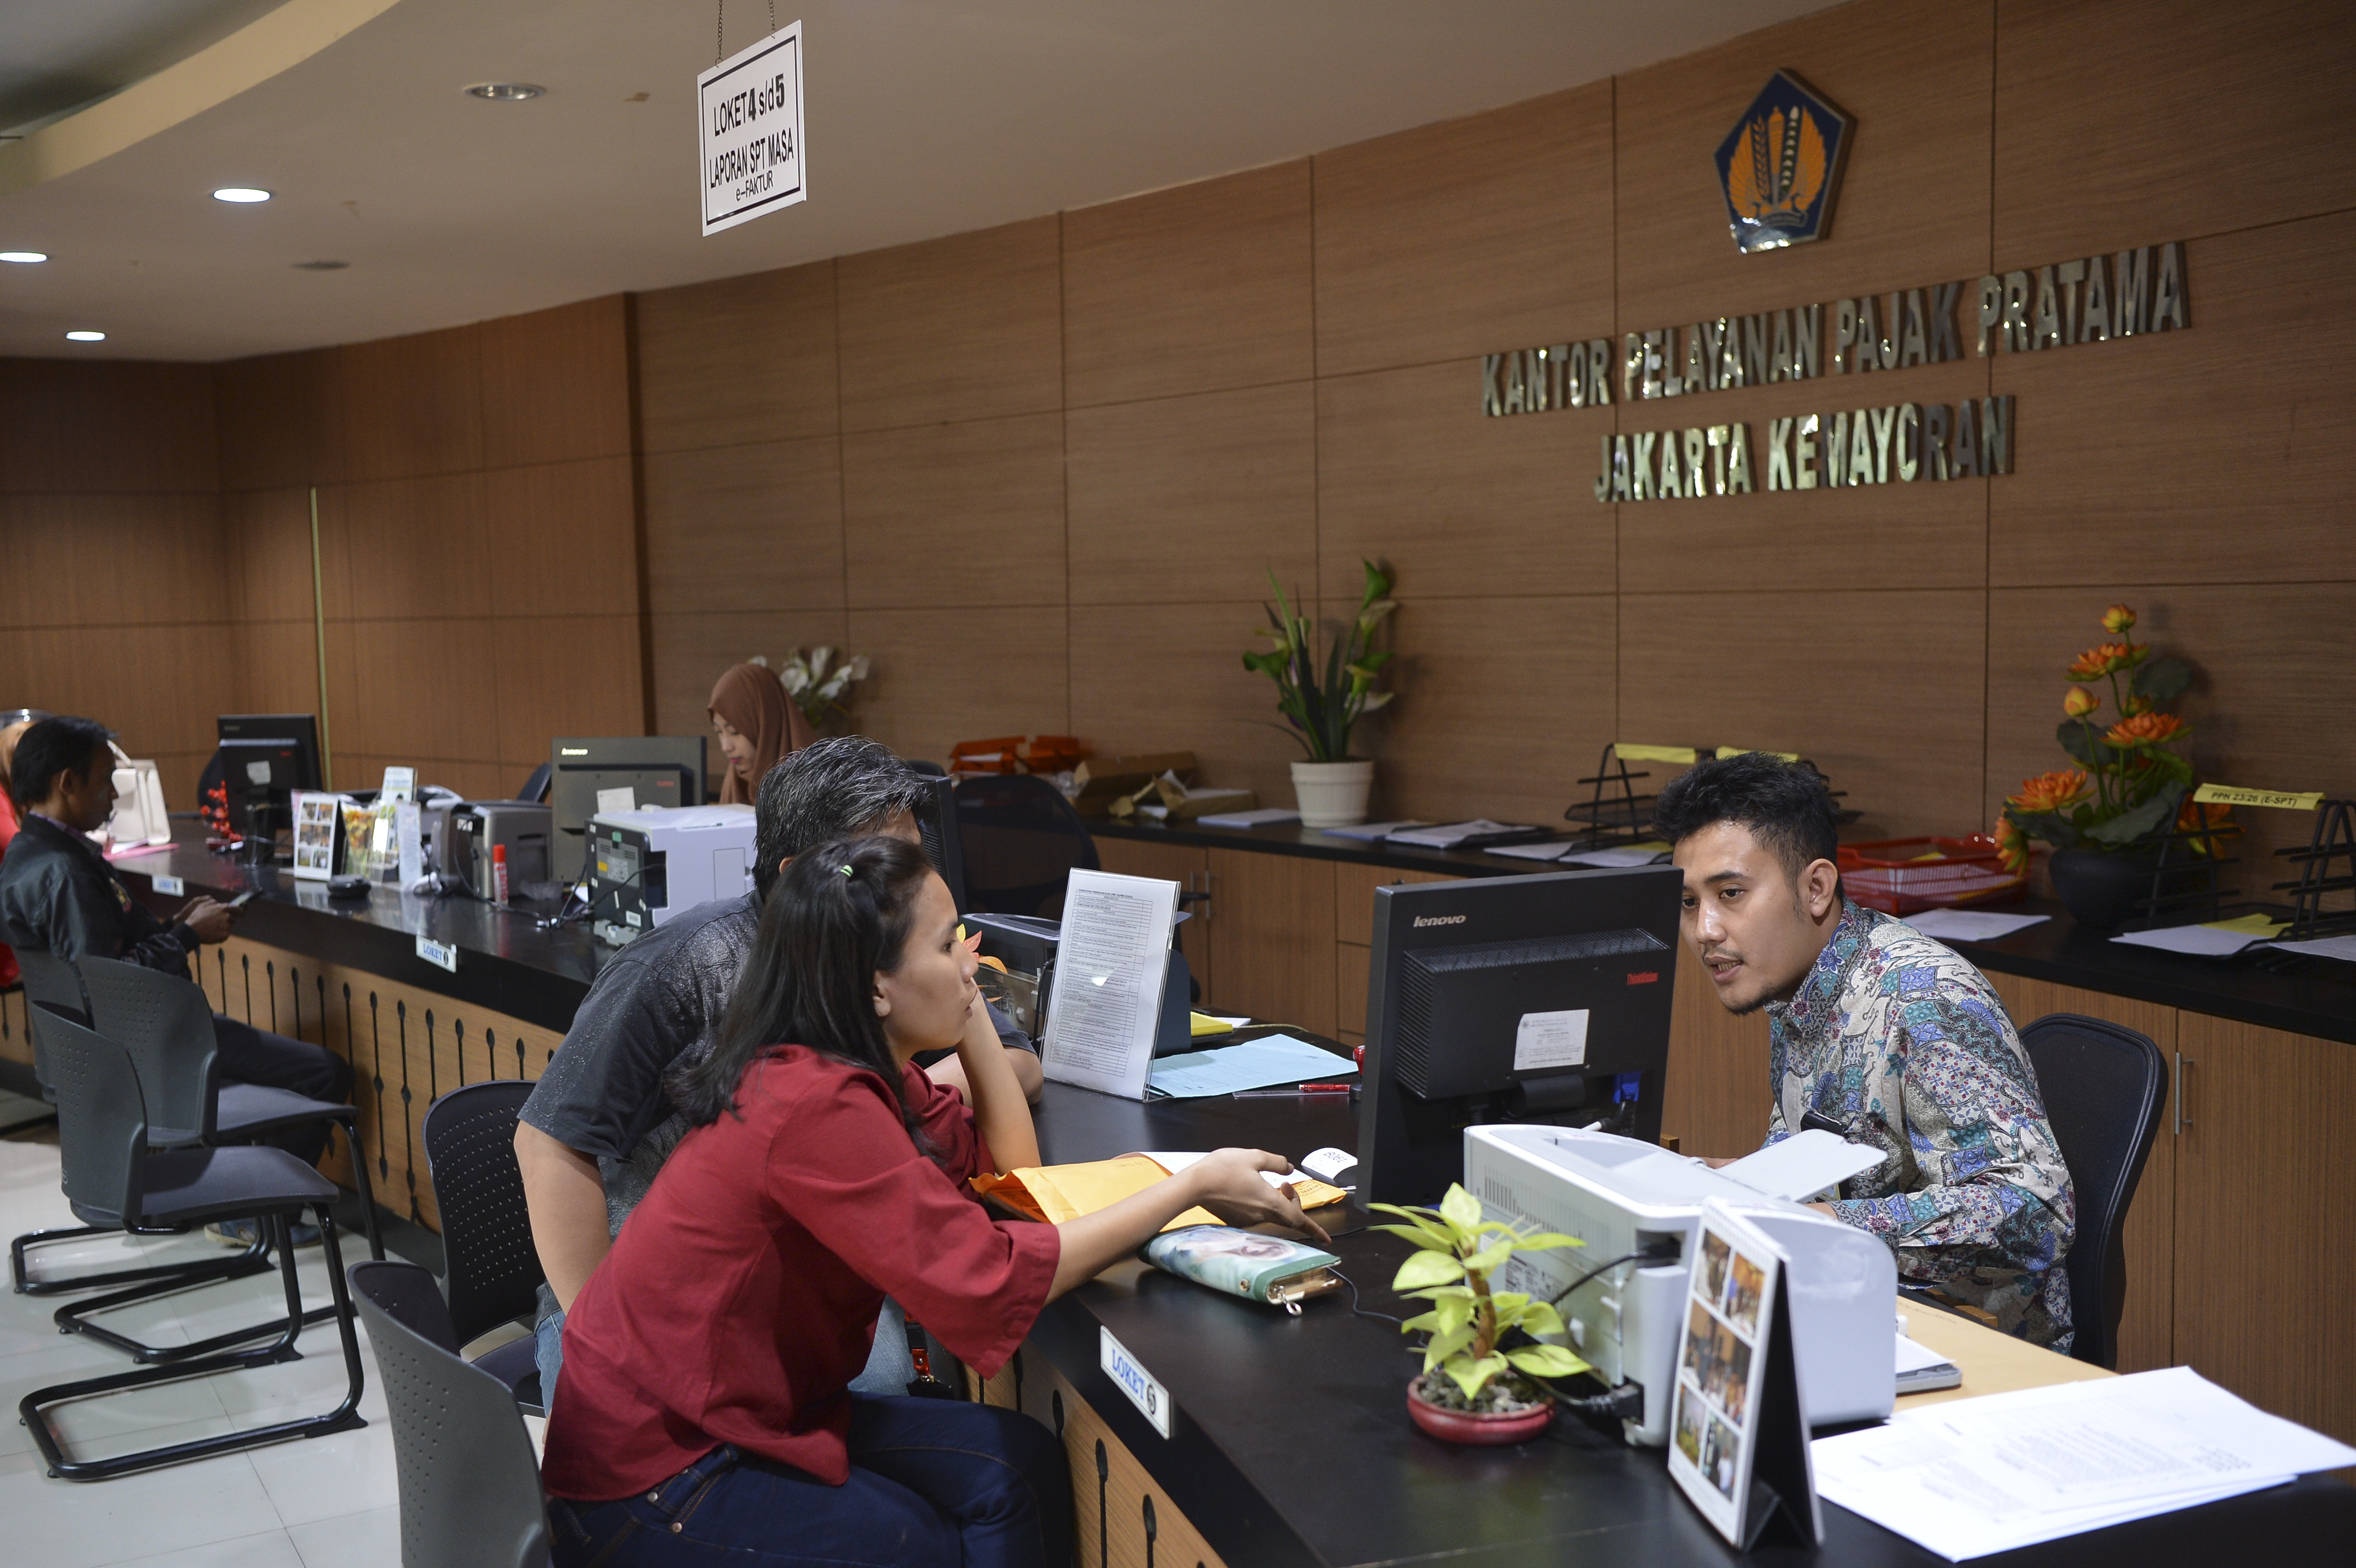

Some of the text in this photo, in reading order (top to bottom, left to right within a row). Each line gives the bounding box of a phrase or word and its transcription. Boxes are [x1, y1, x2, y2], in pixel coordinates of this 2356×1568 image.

[713, 73, 785, 137] LOKET 4 s/d 5
[709, 127, 794, 189] LAPORAN SPT MASA
[736, 170, 773, 201] e-FAKTUR
[1482, 242, 2184, 416] KANTOR PELAYANAN PAJAK PRATAMA
[1594, 395, 2007, 502] JAKARTA KEMAYORAN
[1413, 915, 1467, 928] lenovo
[423, 943, 442, 960] LOKET
[1112, 1348, 1145, 1400] LOKET
